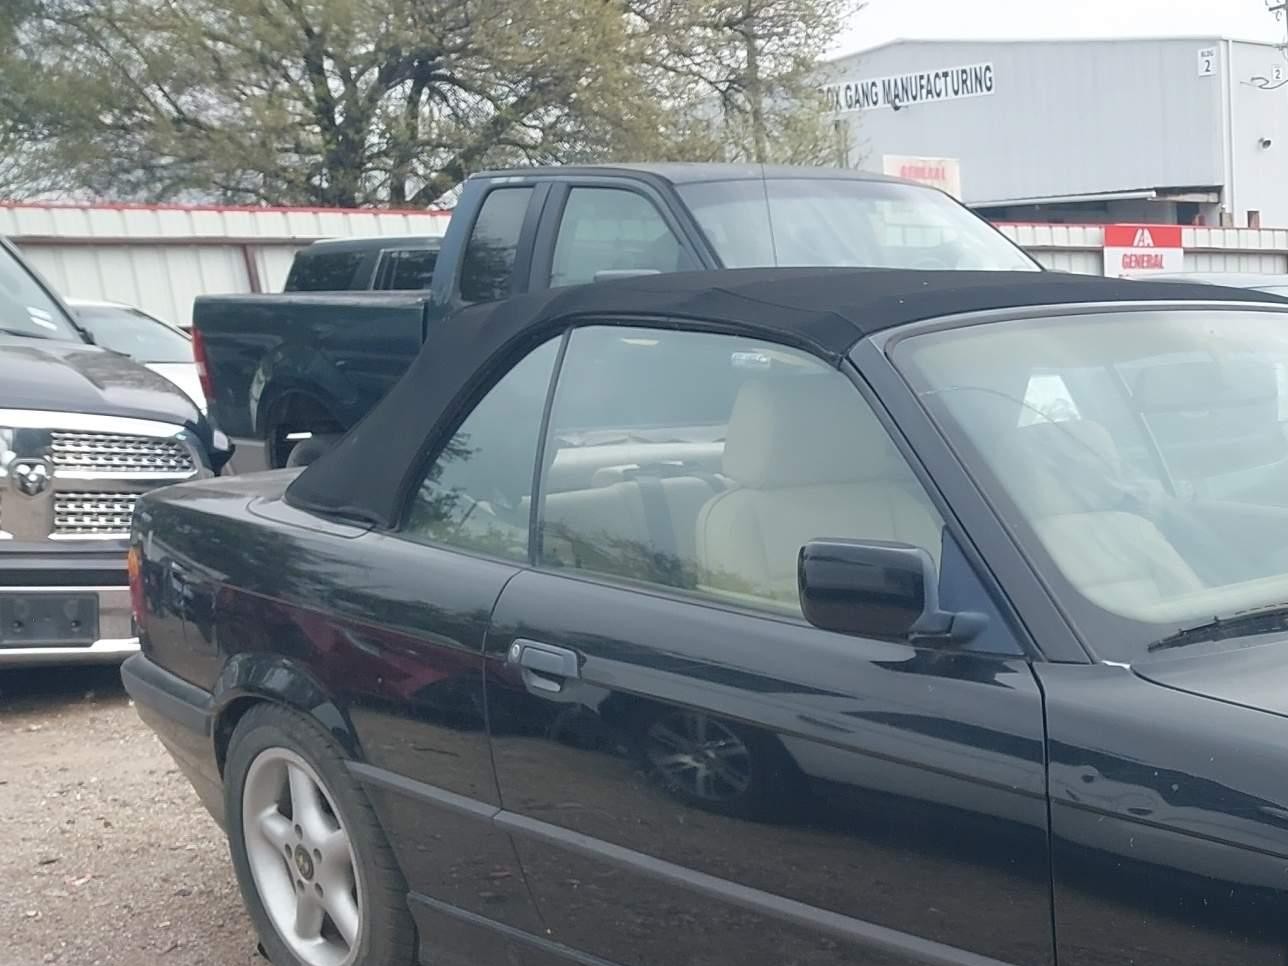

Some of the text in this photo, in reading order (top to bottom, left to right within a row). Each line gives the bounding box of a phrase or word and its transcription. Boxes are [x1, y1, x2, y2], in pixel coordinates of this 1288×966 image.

[1204, 59, 1211, 72] 2
[1274, 69, 1281, 79] 2
[844, 81, 879, 109] GANG
[882, 65, 993, 105] MANUFACTURING
[1122, 253, 1164, 270] GENERAL
